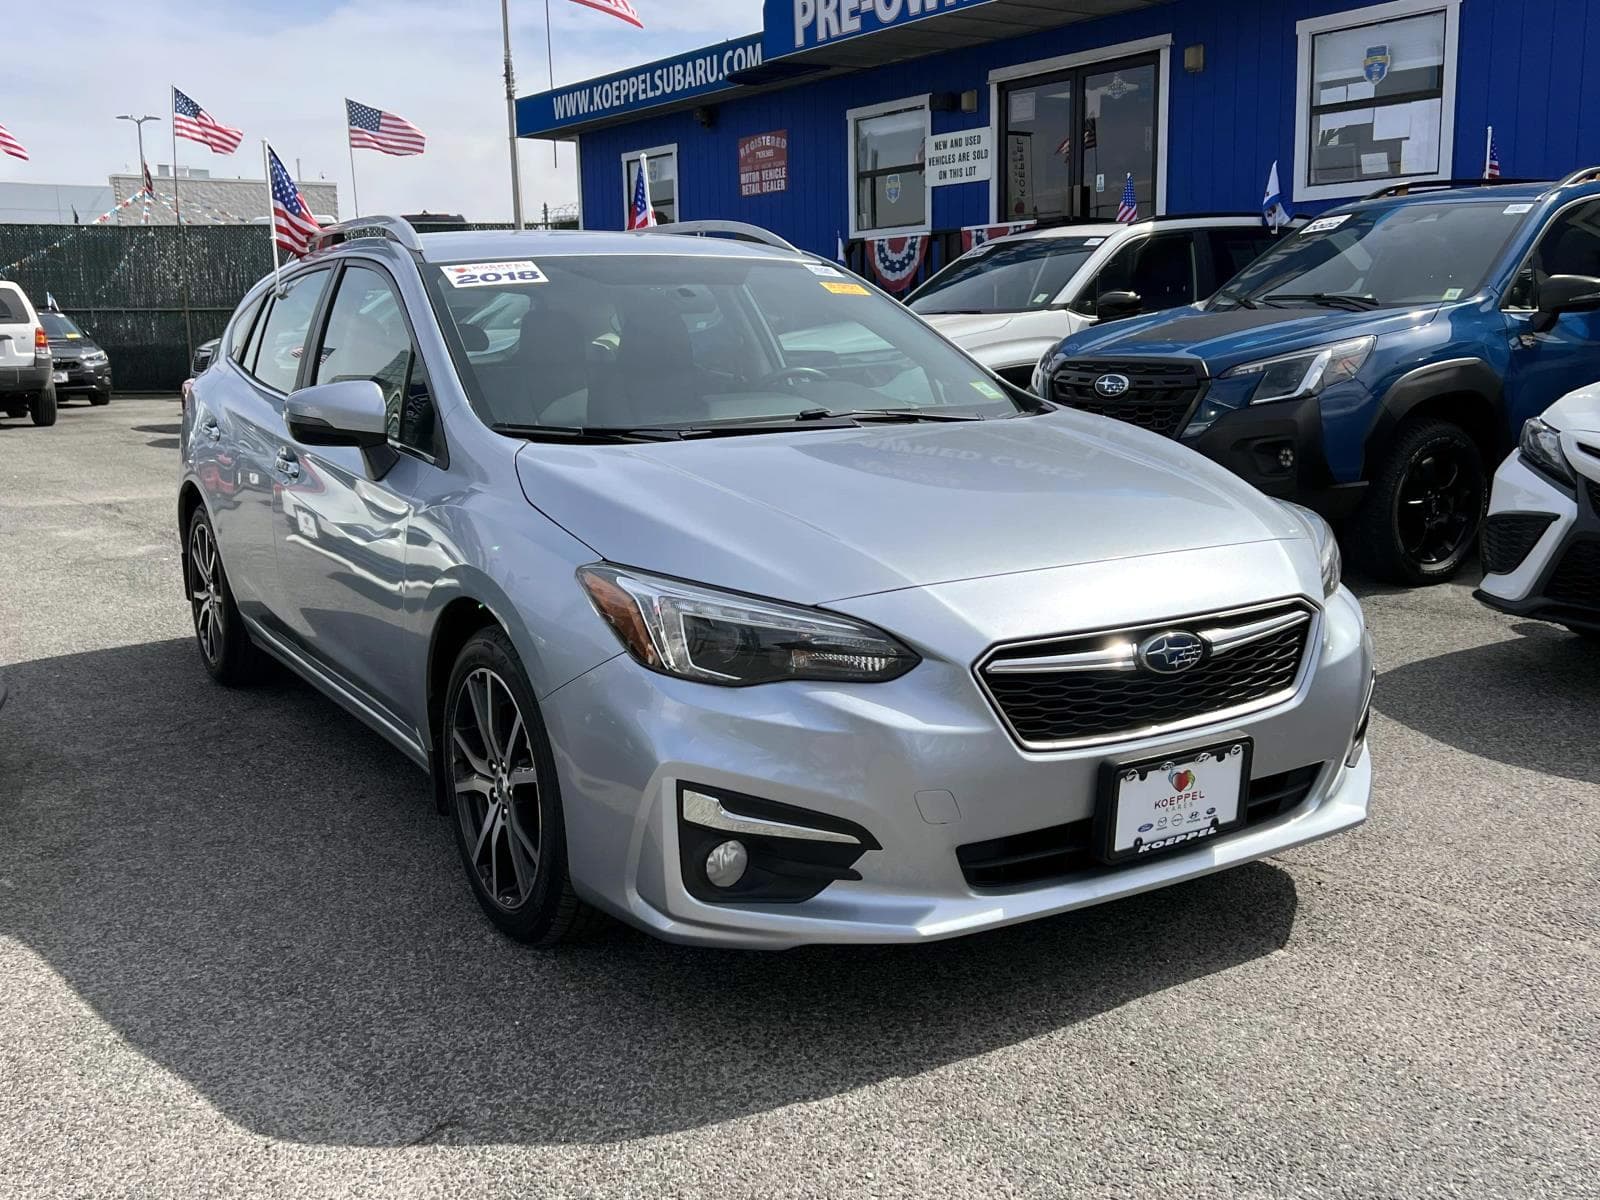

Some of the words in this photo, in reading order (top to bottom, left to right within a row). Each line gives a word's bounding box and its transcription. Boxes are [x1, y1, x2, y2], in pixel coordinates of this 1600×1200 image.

[553, 43, 762, 120] WWW.KOEPPELSUBARU.COM
[740, 135, 787, 159] REGISTERED
[934, 140, 948, 151] NEW
[950, 138, 963, 149] AND
[964, 135, 981, 147] USED
[928, 153, 956, 167] VEHICLES
[957, 151, 970, 162] ARE
[972, 148, 989, 161] SOLD
[741, 171, 760, 185] MOTOR
[762, 167, 786, 181] VEHICLE
[938, 170, 947, 180] ON
[949, 168, 963, 179] THIS
[965, 165, 977, 177] LOT
[742, 182, 761, 196] RETAIL
[762, 179, 786, 192] DEALER
[456, 270, 540, 284] 2018
[1154, 790, 1205, 810] KOEPPEL
[1138, 827, 1216, 853] KOEPPEL
